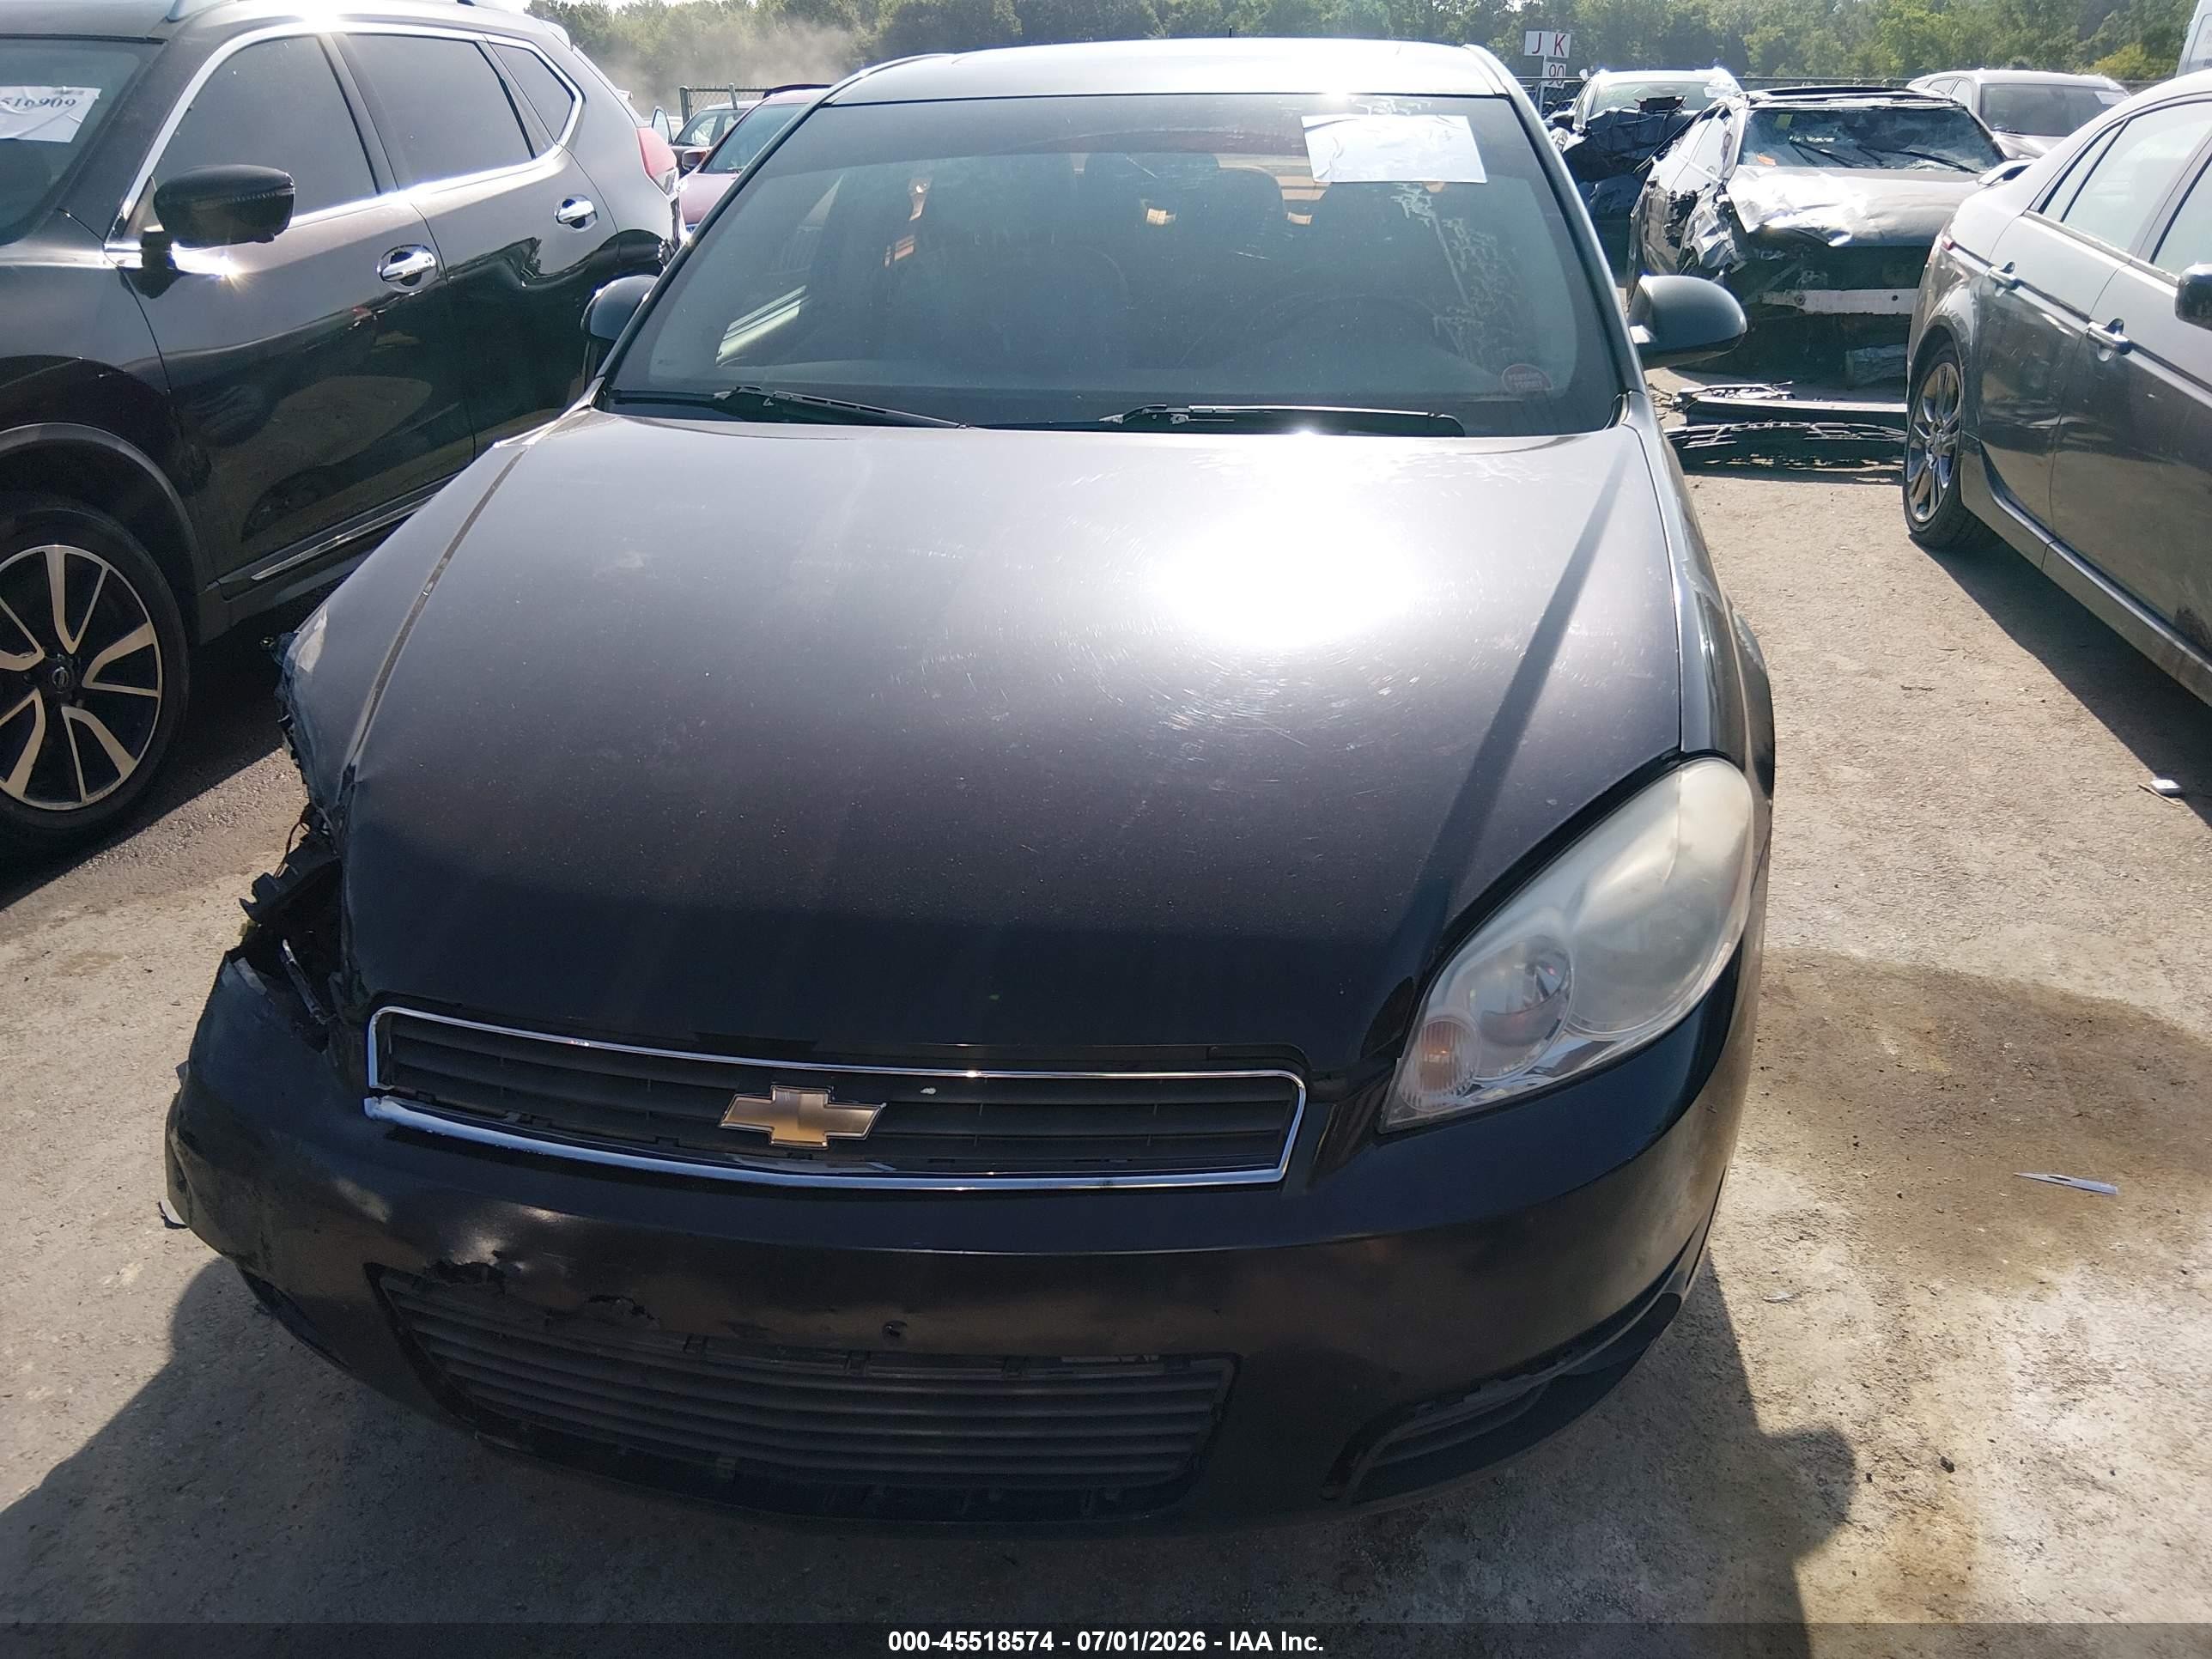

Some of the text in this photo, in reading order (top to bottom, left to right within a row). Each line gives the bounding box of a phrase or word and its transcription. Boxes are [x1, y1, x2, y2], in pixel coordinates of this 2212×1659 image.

[1531, 33, 1566, 57] J K
[1548, 64, 1565, 87] 90
